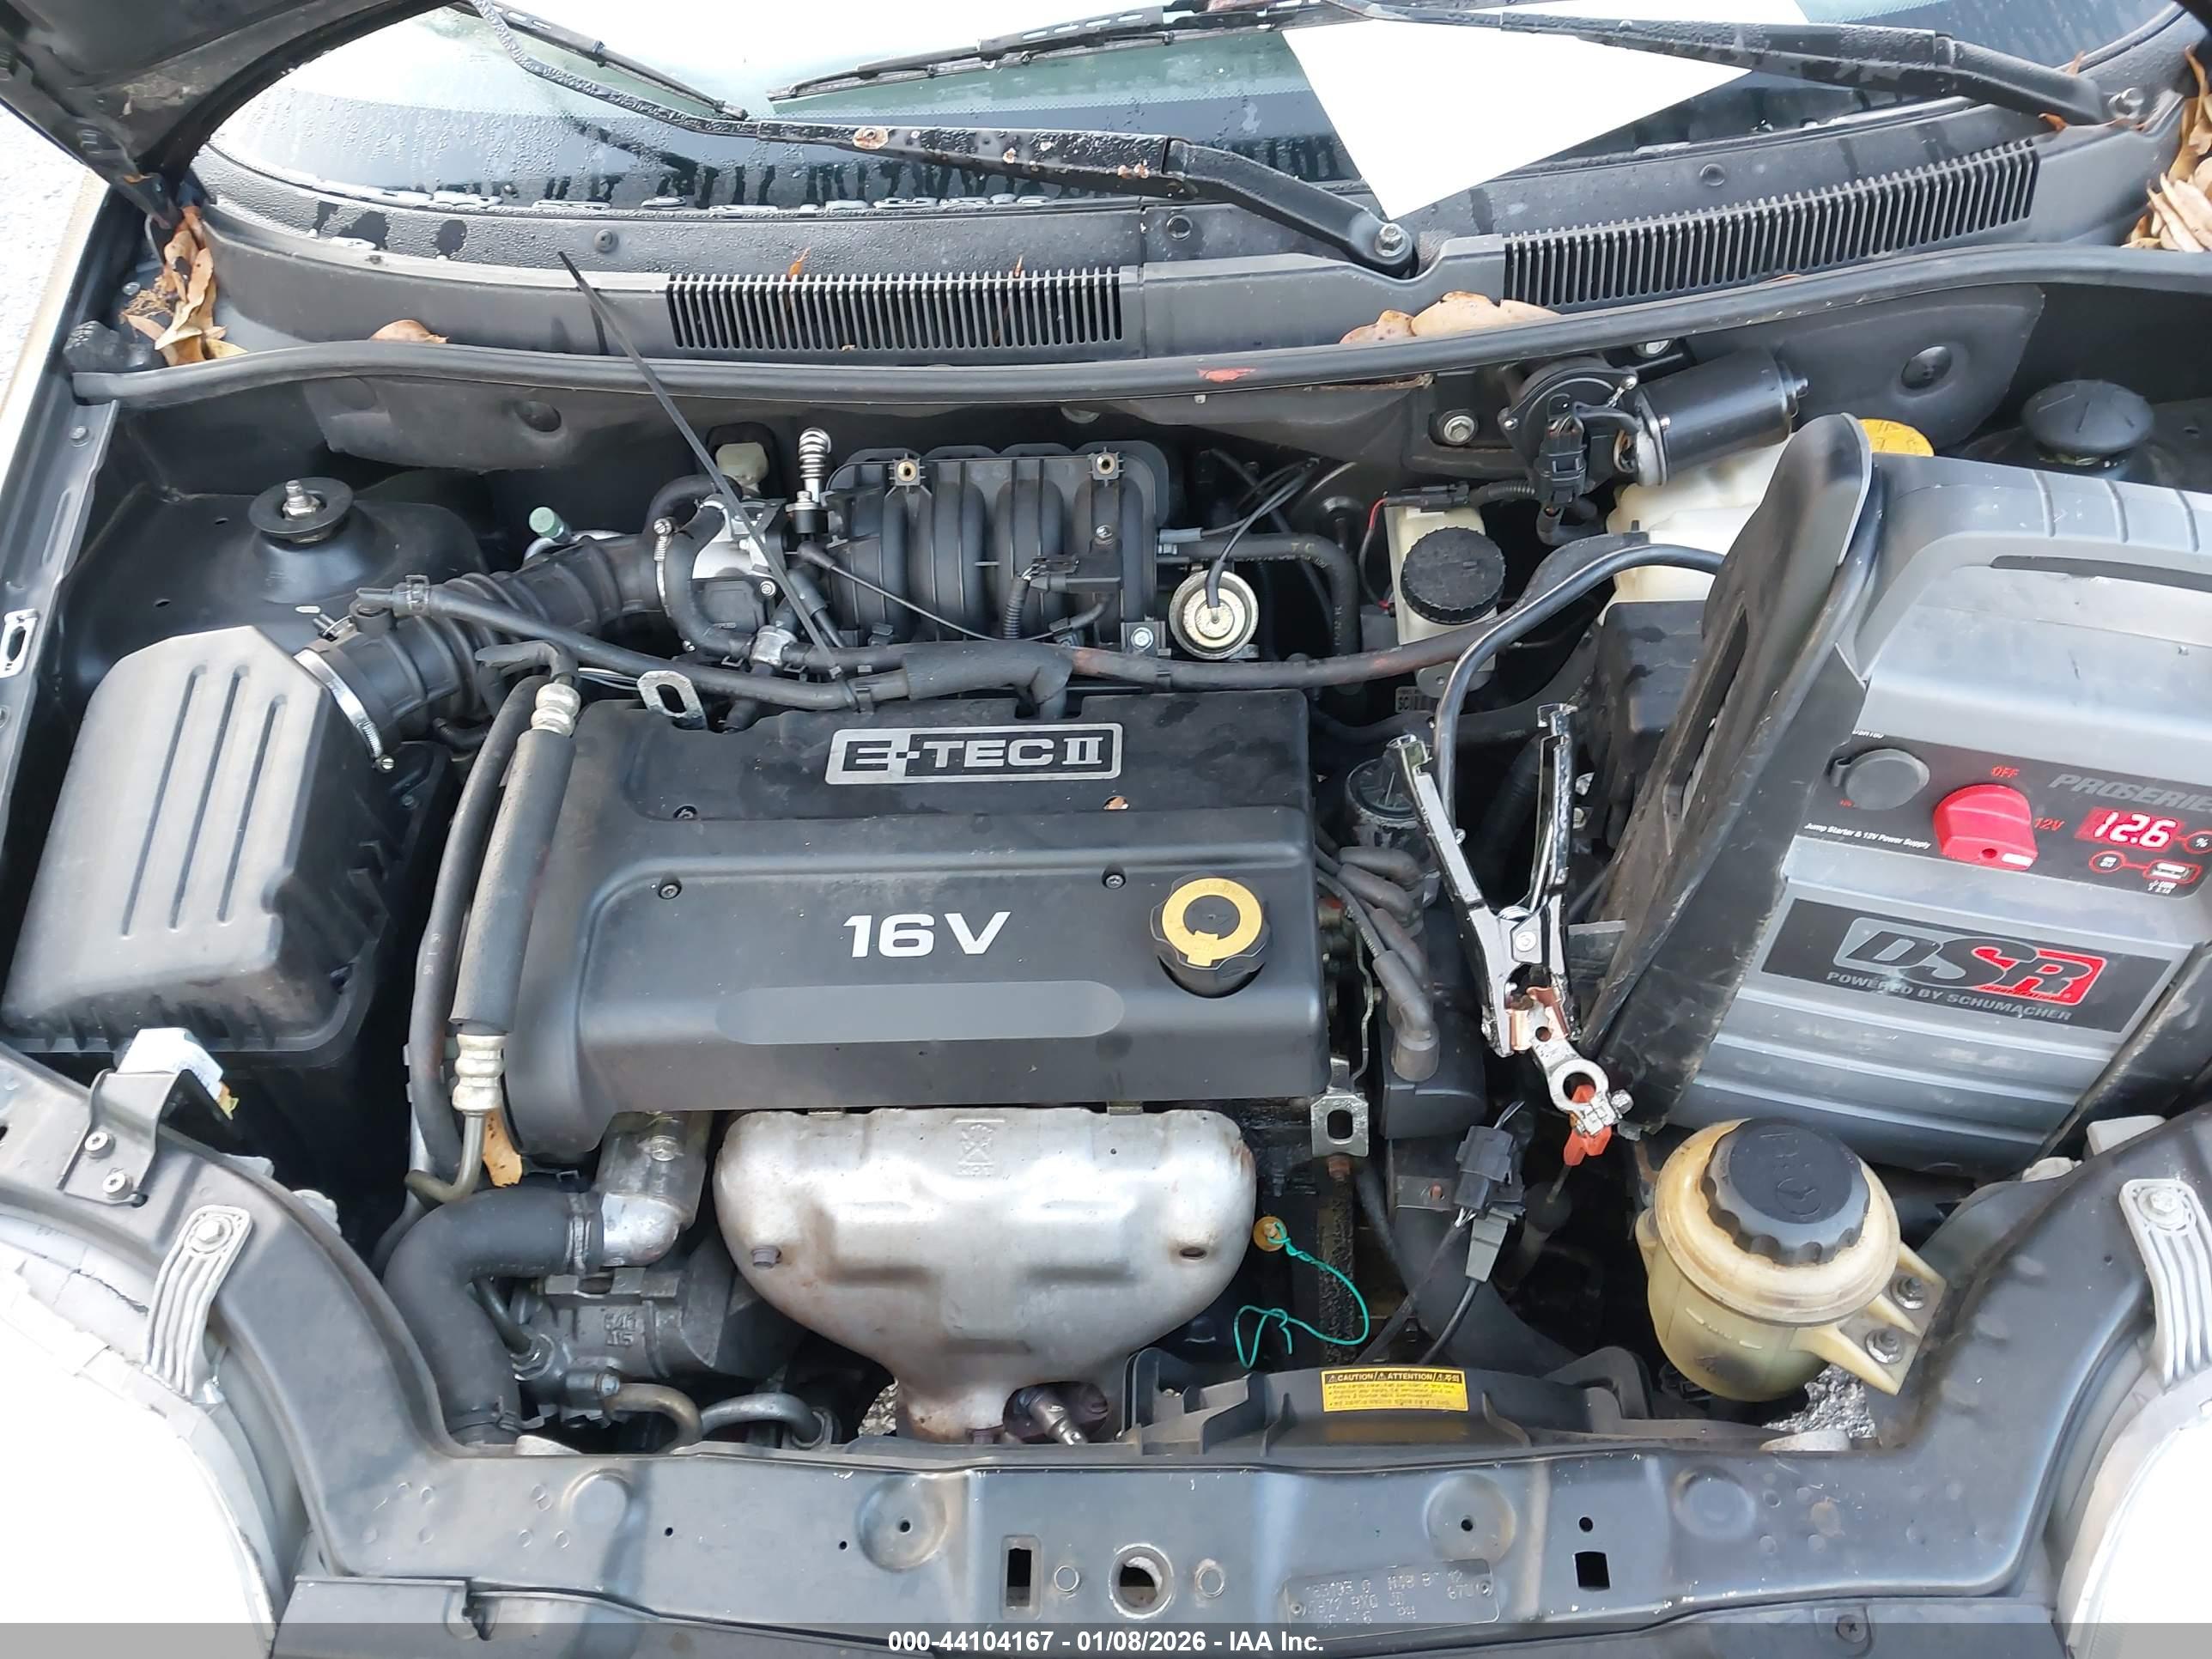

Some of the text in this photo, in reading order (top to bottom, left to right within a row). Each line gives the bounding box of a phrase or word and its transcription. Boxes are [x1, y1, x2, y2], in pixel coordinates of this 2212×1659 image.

[1991, 766, 2021, 778] OFF
[2048, 774, 2212, 814] PROSERIE
[1804, 823, 1826, 833] Jump
[1826, 826, 1853, 836] Starter
[1863, 832, 1879, 841] 12V
[1878, 835, 1903, 844] Power
[1903, 839, 1931, 849] Supply
[2033, 817, 2066, 832] 12V
[2093, 811, 2179, 848] 12.6
[1845, 930, 2094, 997] DSR
[1826, 971, 1913, 996] POWERED
[1918, 988, 1944, 1000] BY
[1947, 993, 2073, 1021] SCHUMACHER
